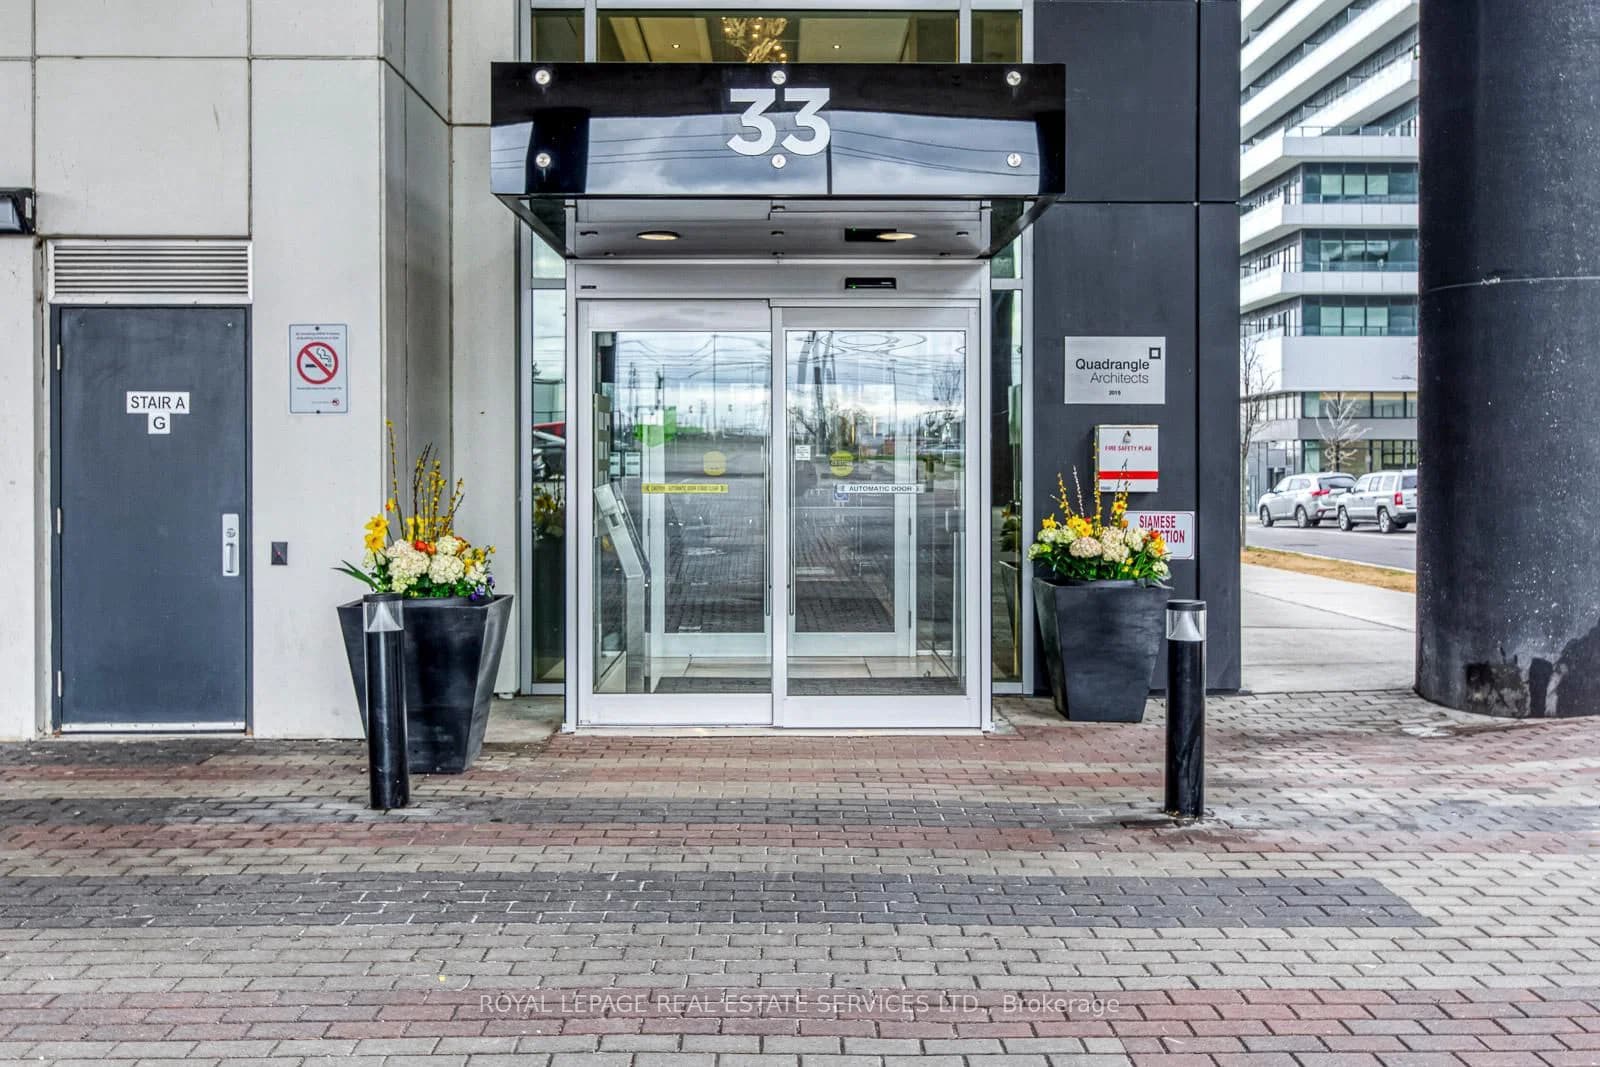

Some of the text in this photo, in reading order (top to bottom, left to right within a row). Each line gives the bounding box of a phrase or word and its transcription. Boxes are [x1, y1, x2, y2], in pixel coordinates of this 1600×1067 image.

[727, 87, 831, 156] 33
[1075, 358, 1150, 373] Quadrangle
[1089, 372, 1149, 384] Architects
[130, 395, 186, 409] STAIR A
[153, 416, 166, 430] G
[1139, 515, 1176, 529] SIAMESE
